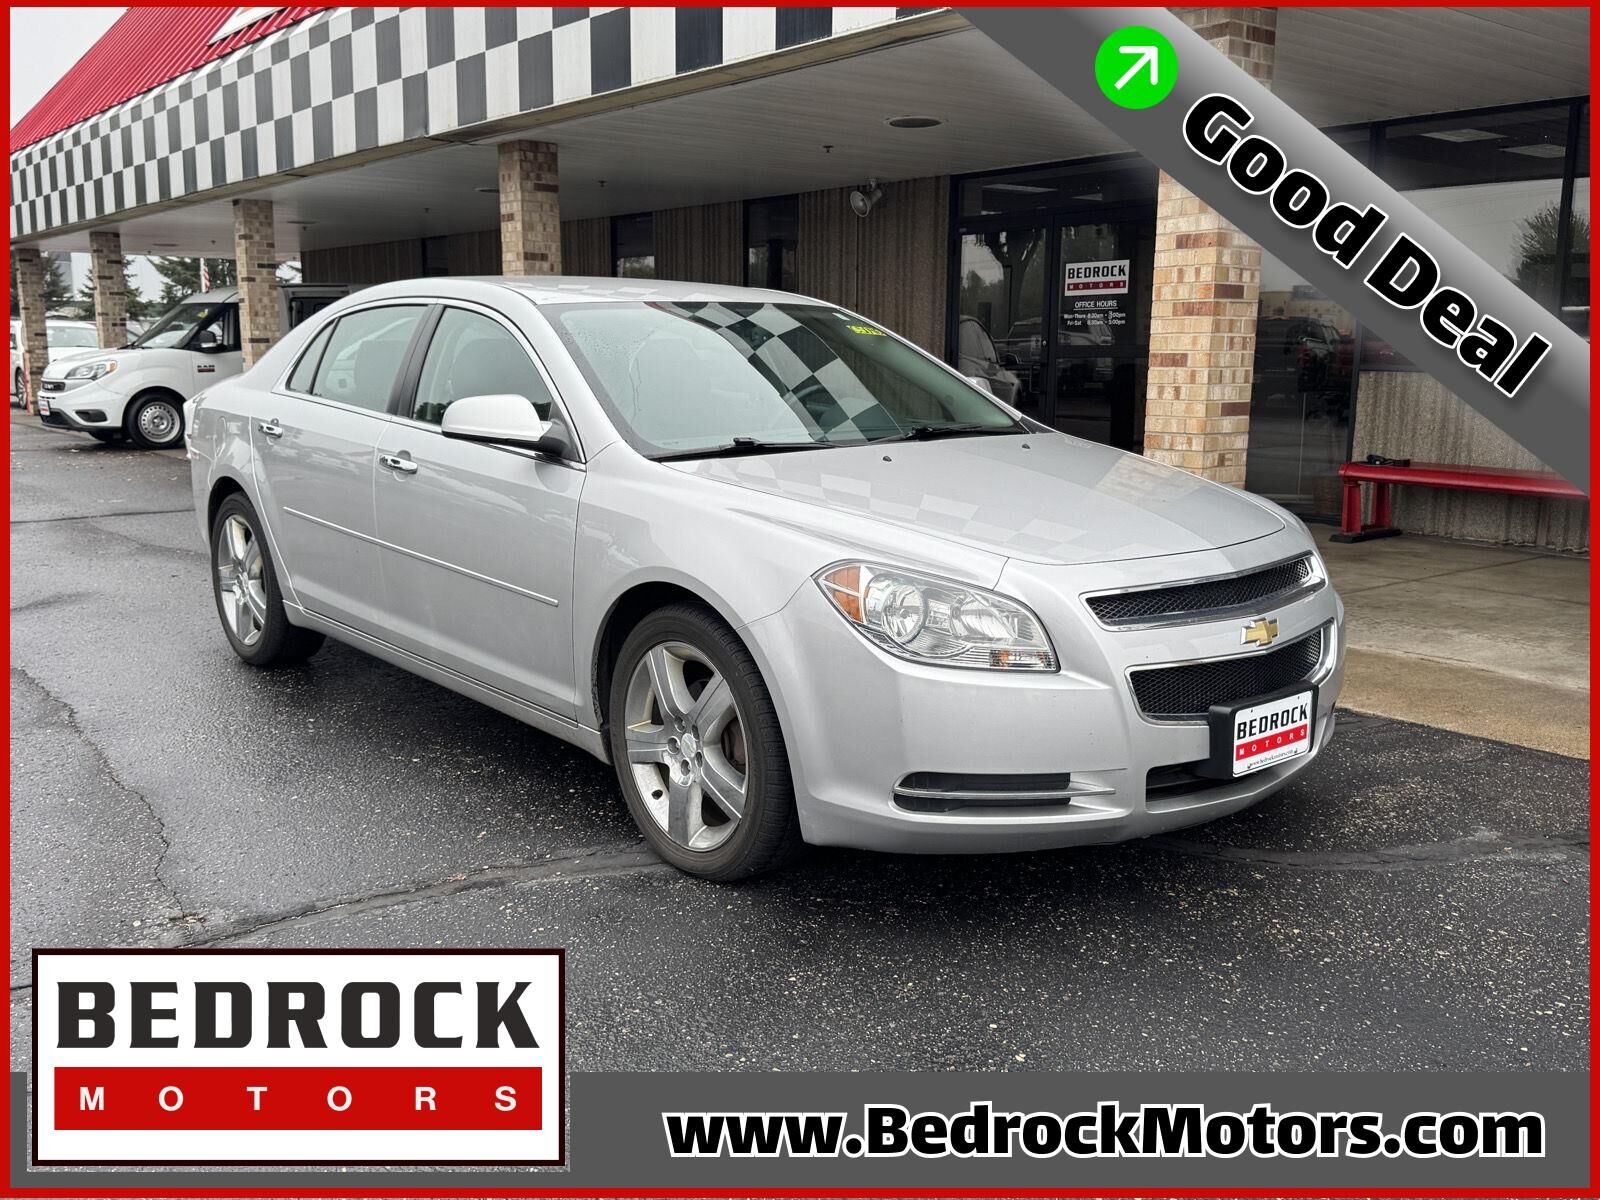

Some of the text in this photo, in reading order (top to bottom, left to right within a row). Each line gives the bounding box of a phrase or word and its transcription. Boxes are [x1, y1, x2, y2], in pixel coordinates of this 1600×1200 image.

[1068, 265, 1126, 279] BEDROCK
[1069, 281, 1124, 290] MOTORS
[1237, 703, 1308, 740] BEDROCK
[1239, 728, 1305, 756] MOTORS
